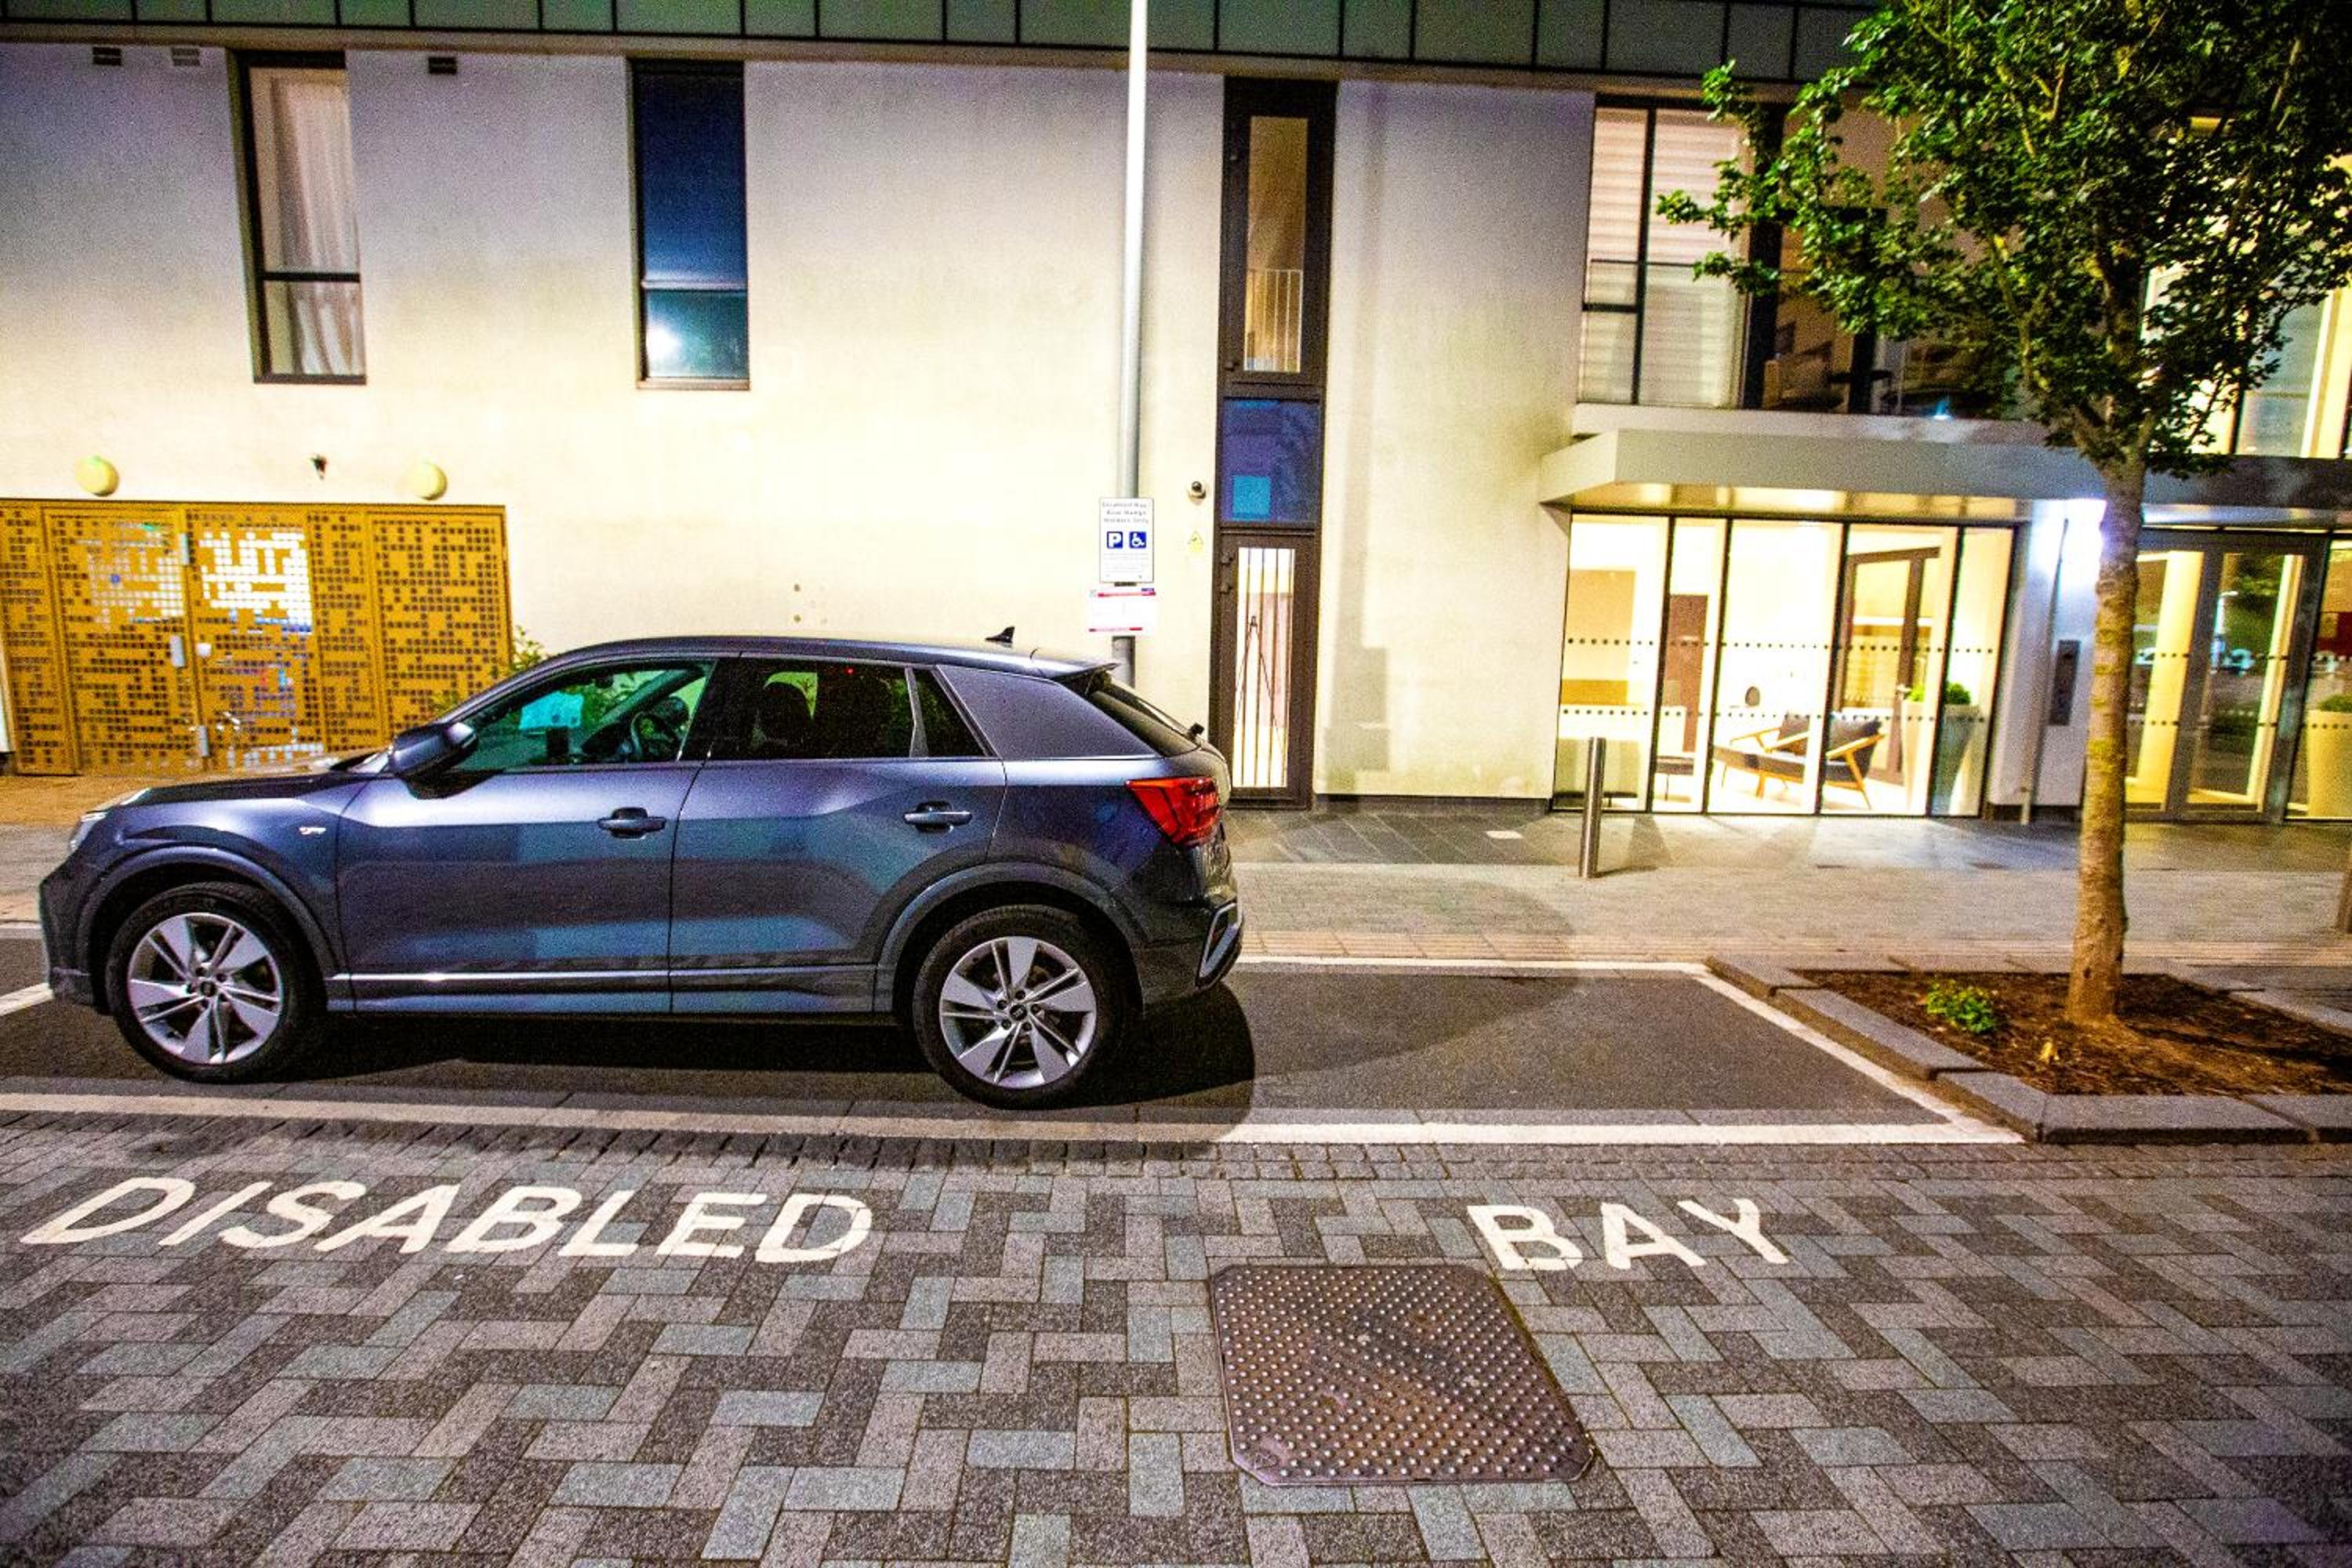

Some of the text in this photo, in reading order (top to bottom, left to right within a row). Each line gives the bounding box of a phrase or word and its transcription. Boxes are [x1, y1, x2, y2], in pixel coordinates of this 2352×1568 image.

[1109, 532, 1121, 548] P
[21, 1178, 1789, 1270] DISABLED BAY
